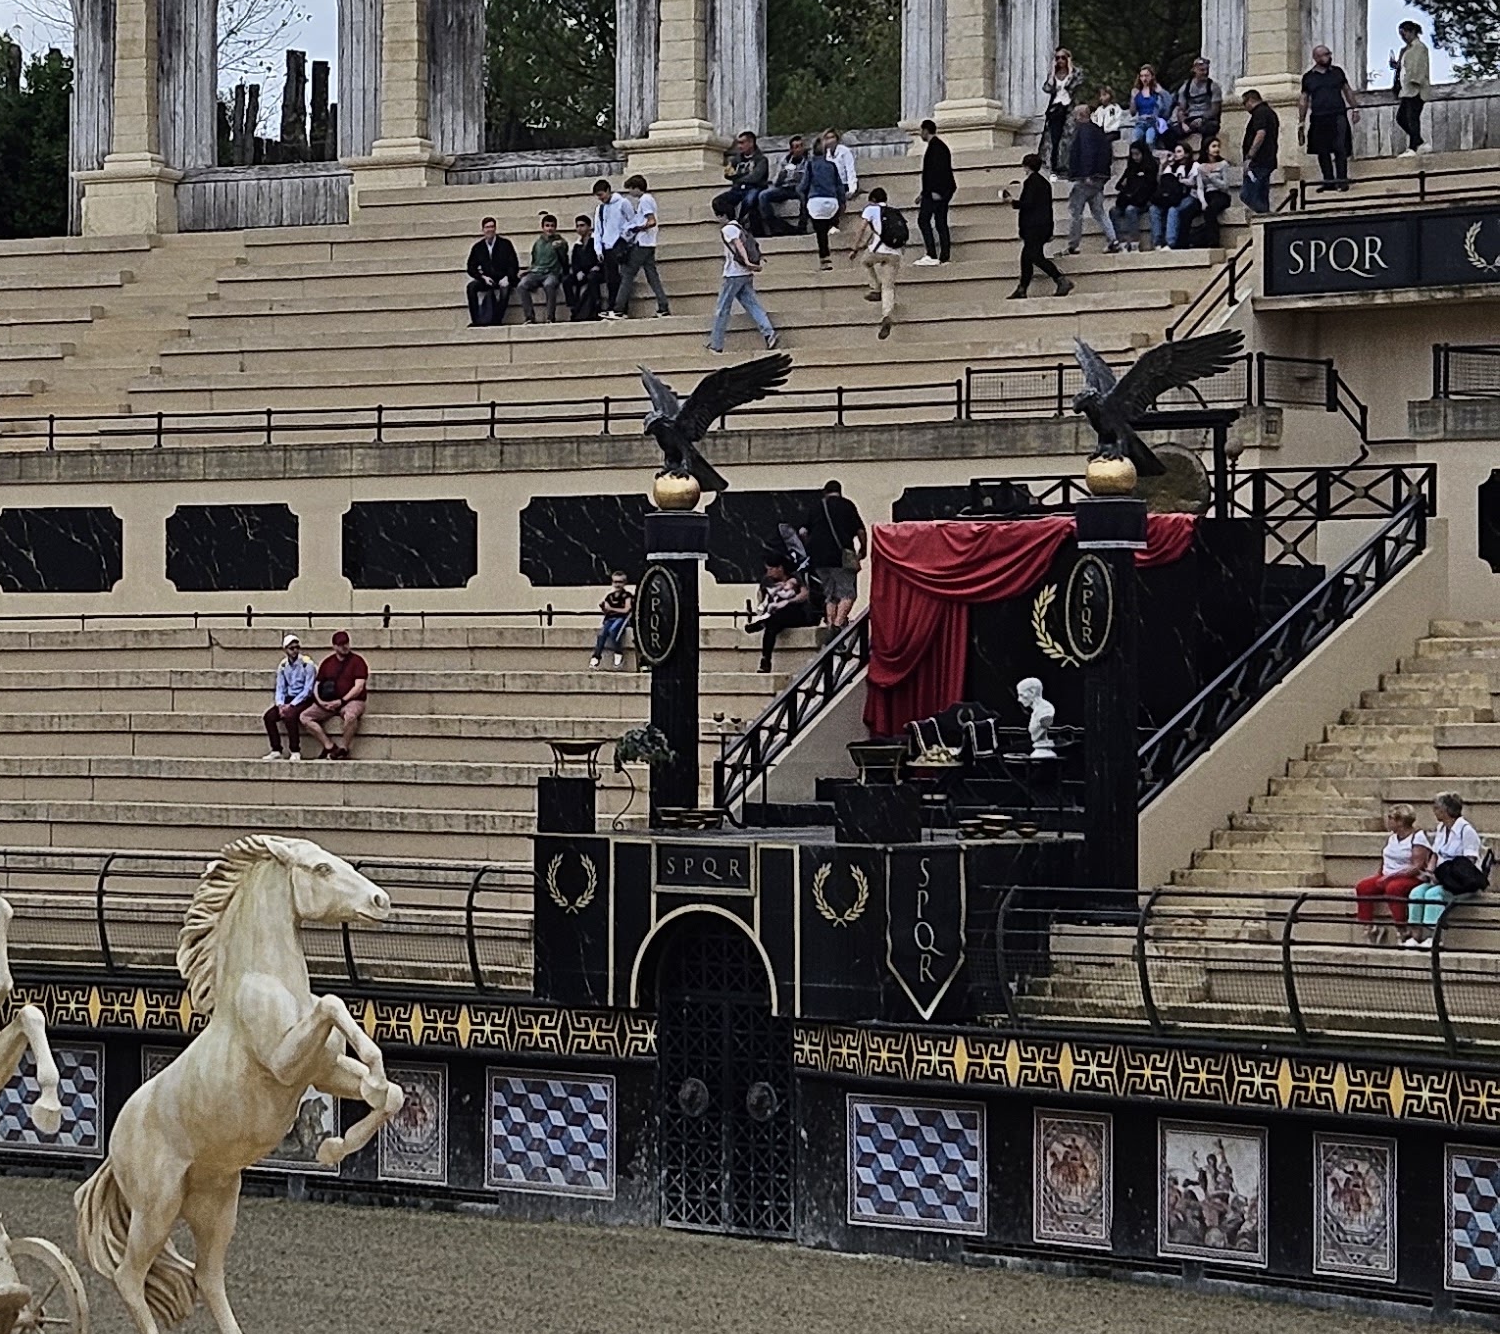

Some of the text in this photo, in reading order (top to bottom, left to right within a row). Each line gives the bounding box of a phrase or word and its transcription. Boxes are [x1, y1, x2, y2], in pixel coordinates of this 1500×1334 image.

[1287, 236, 1389, 278] SPQR
[650, 579, 661, 649] SPQR
[1081, 570, 1094, 644] SPQR
[666, 856, 742, 880] SPQR
[914, 857, 946, 983] SPQR
